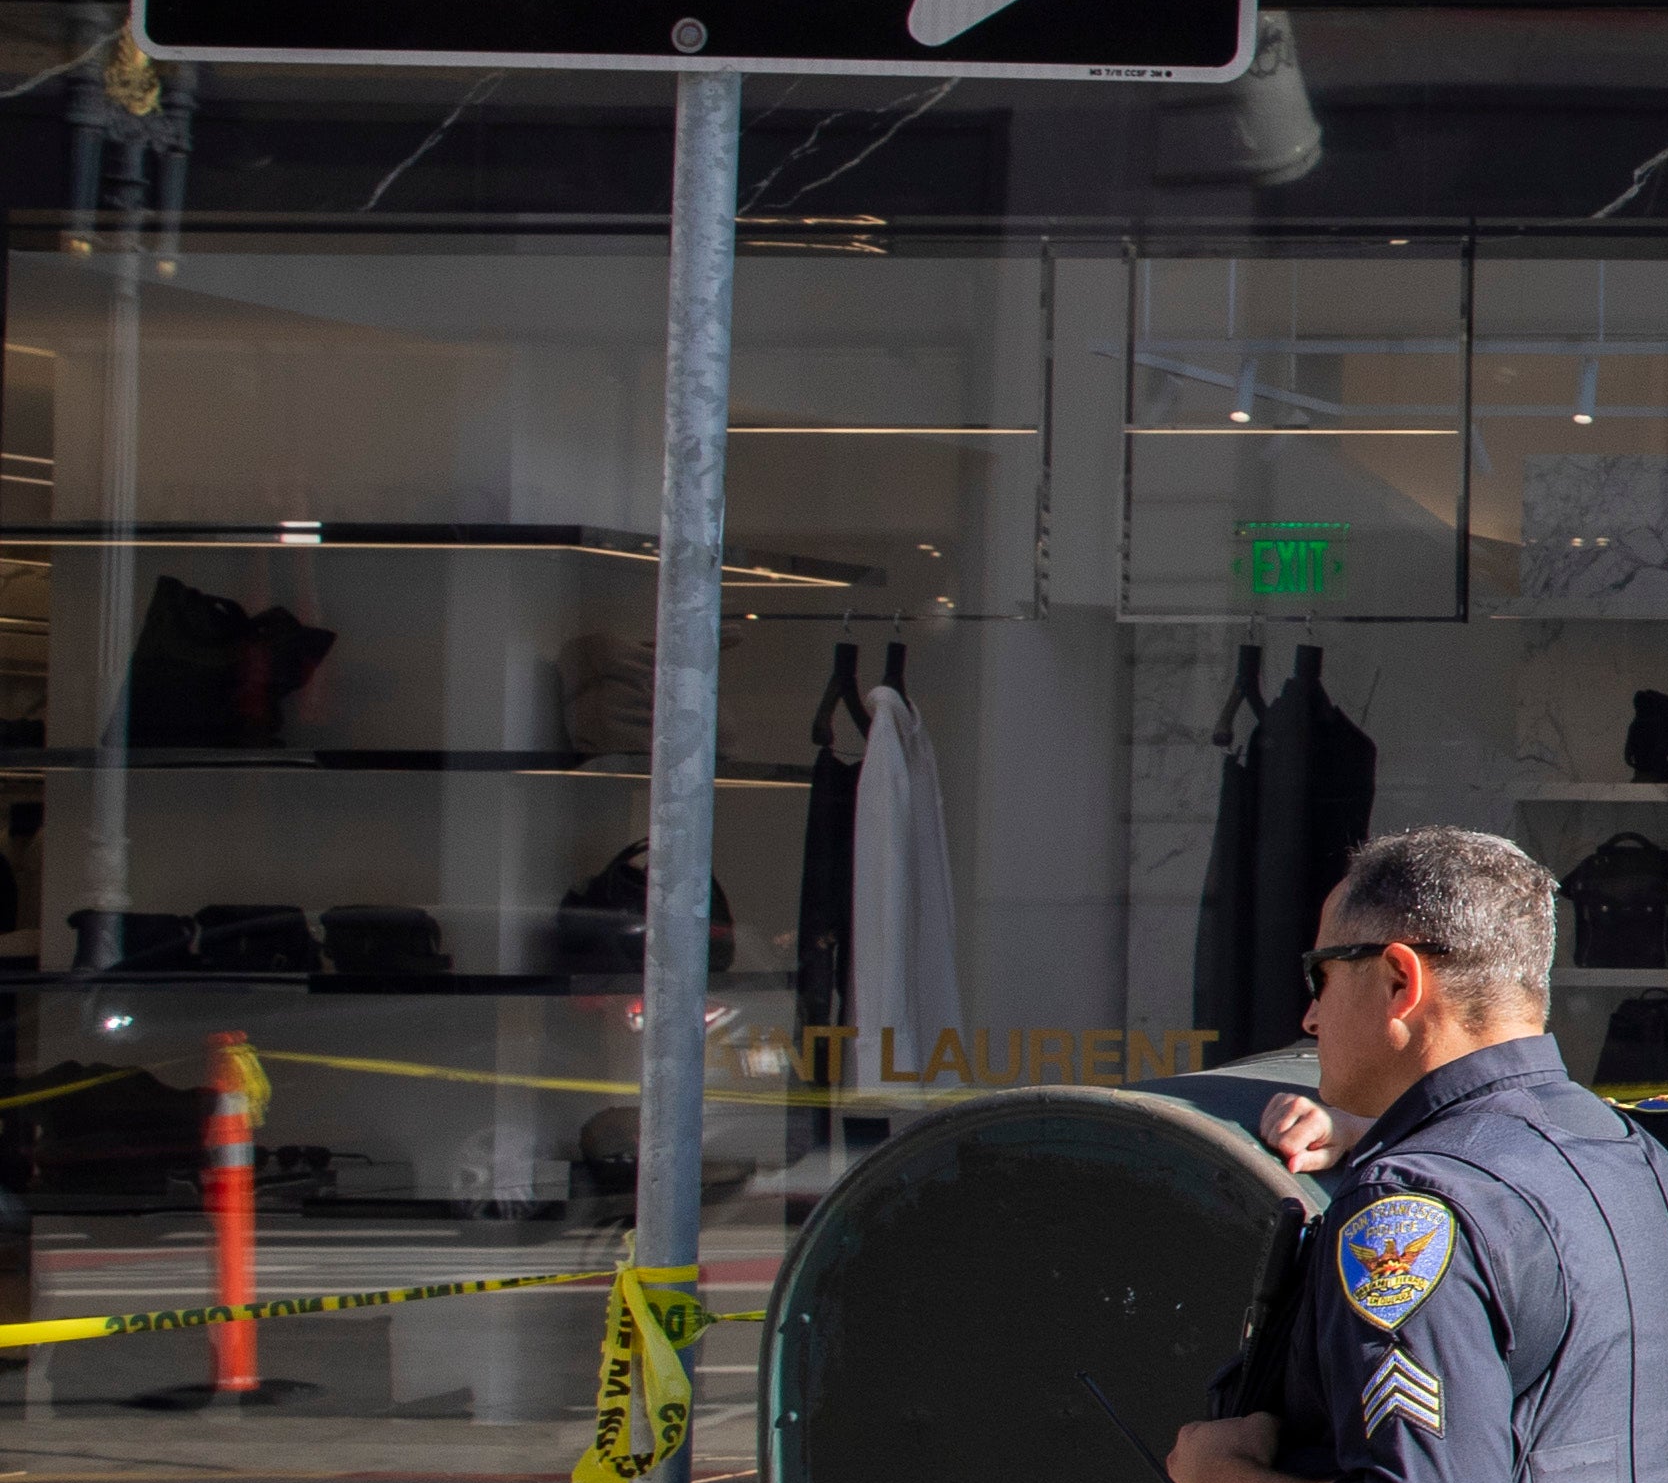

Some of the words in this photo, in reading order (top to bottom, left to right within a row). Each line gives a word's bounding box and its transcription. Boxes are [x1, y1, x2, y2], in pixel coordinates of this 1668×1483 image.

[1252, 541, 1330, 595] EXIT
[880, 1027, 1219, 1086] LAURENT
[1366, 1219, 1419, 1239] POLICE
